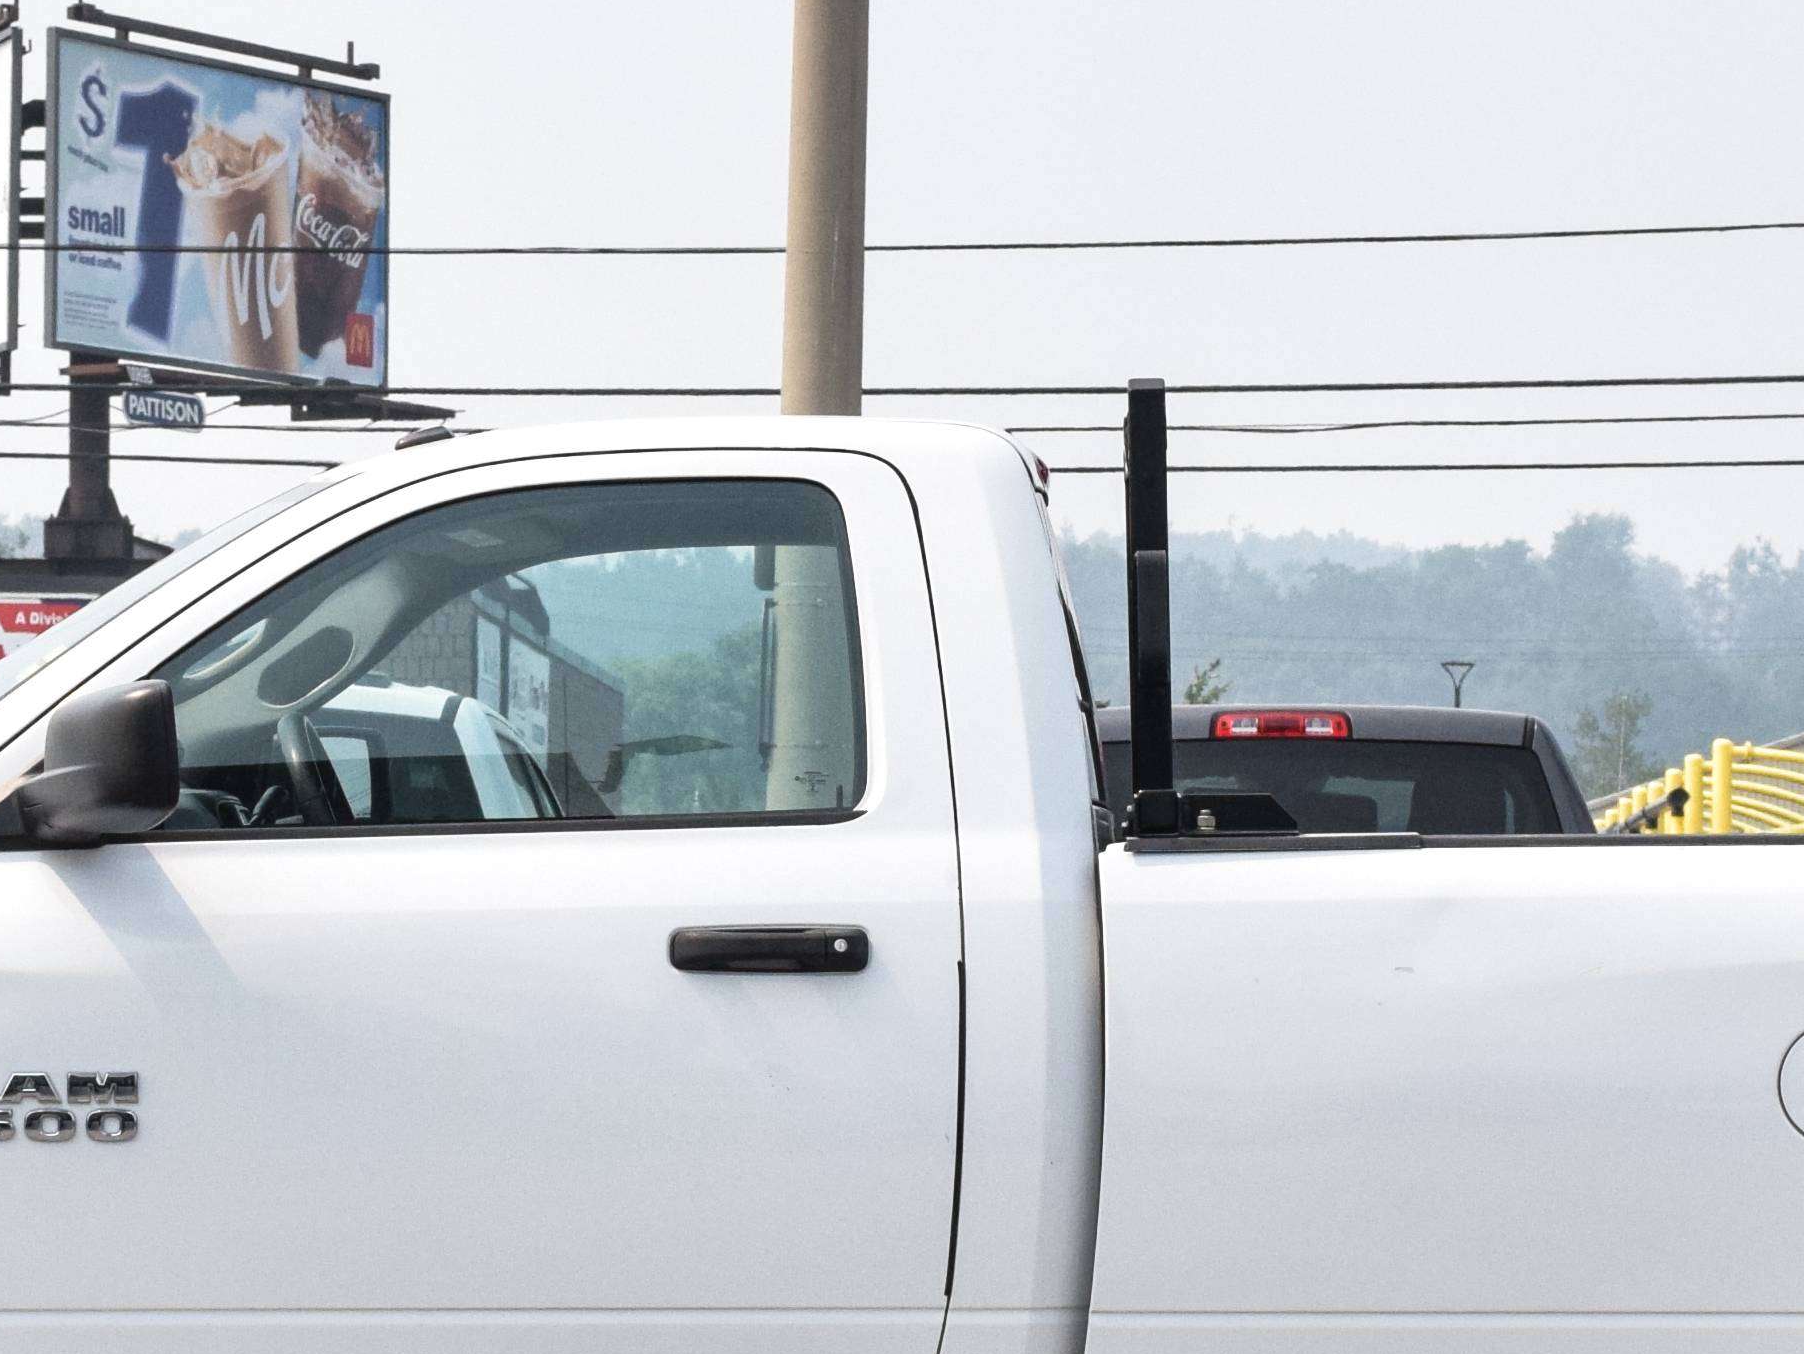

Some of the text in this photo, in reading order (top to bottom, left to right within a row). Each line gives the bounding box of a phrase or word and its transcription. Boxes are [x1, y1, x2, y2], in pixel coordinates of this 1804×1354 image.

[68, 205, 126, 238] small
[128, 394, 200, 424] PATTISON
[15, 611, 25, 624] A
